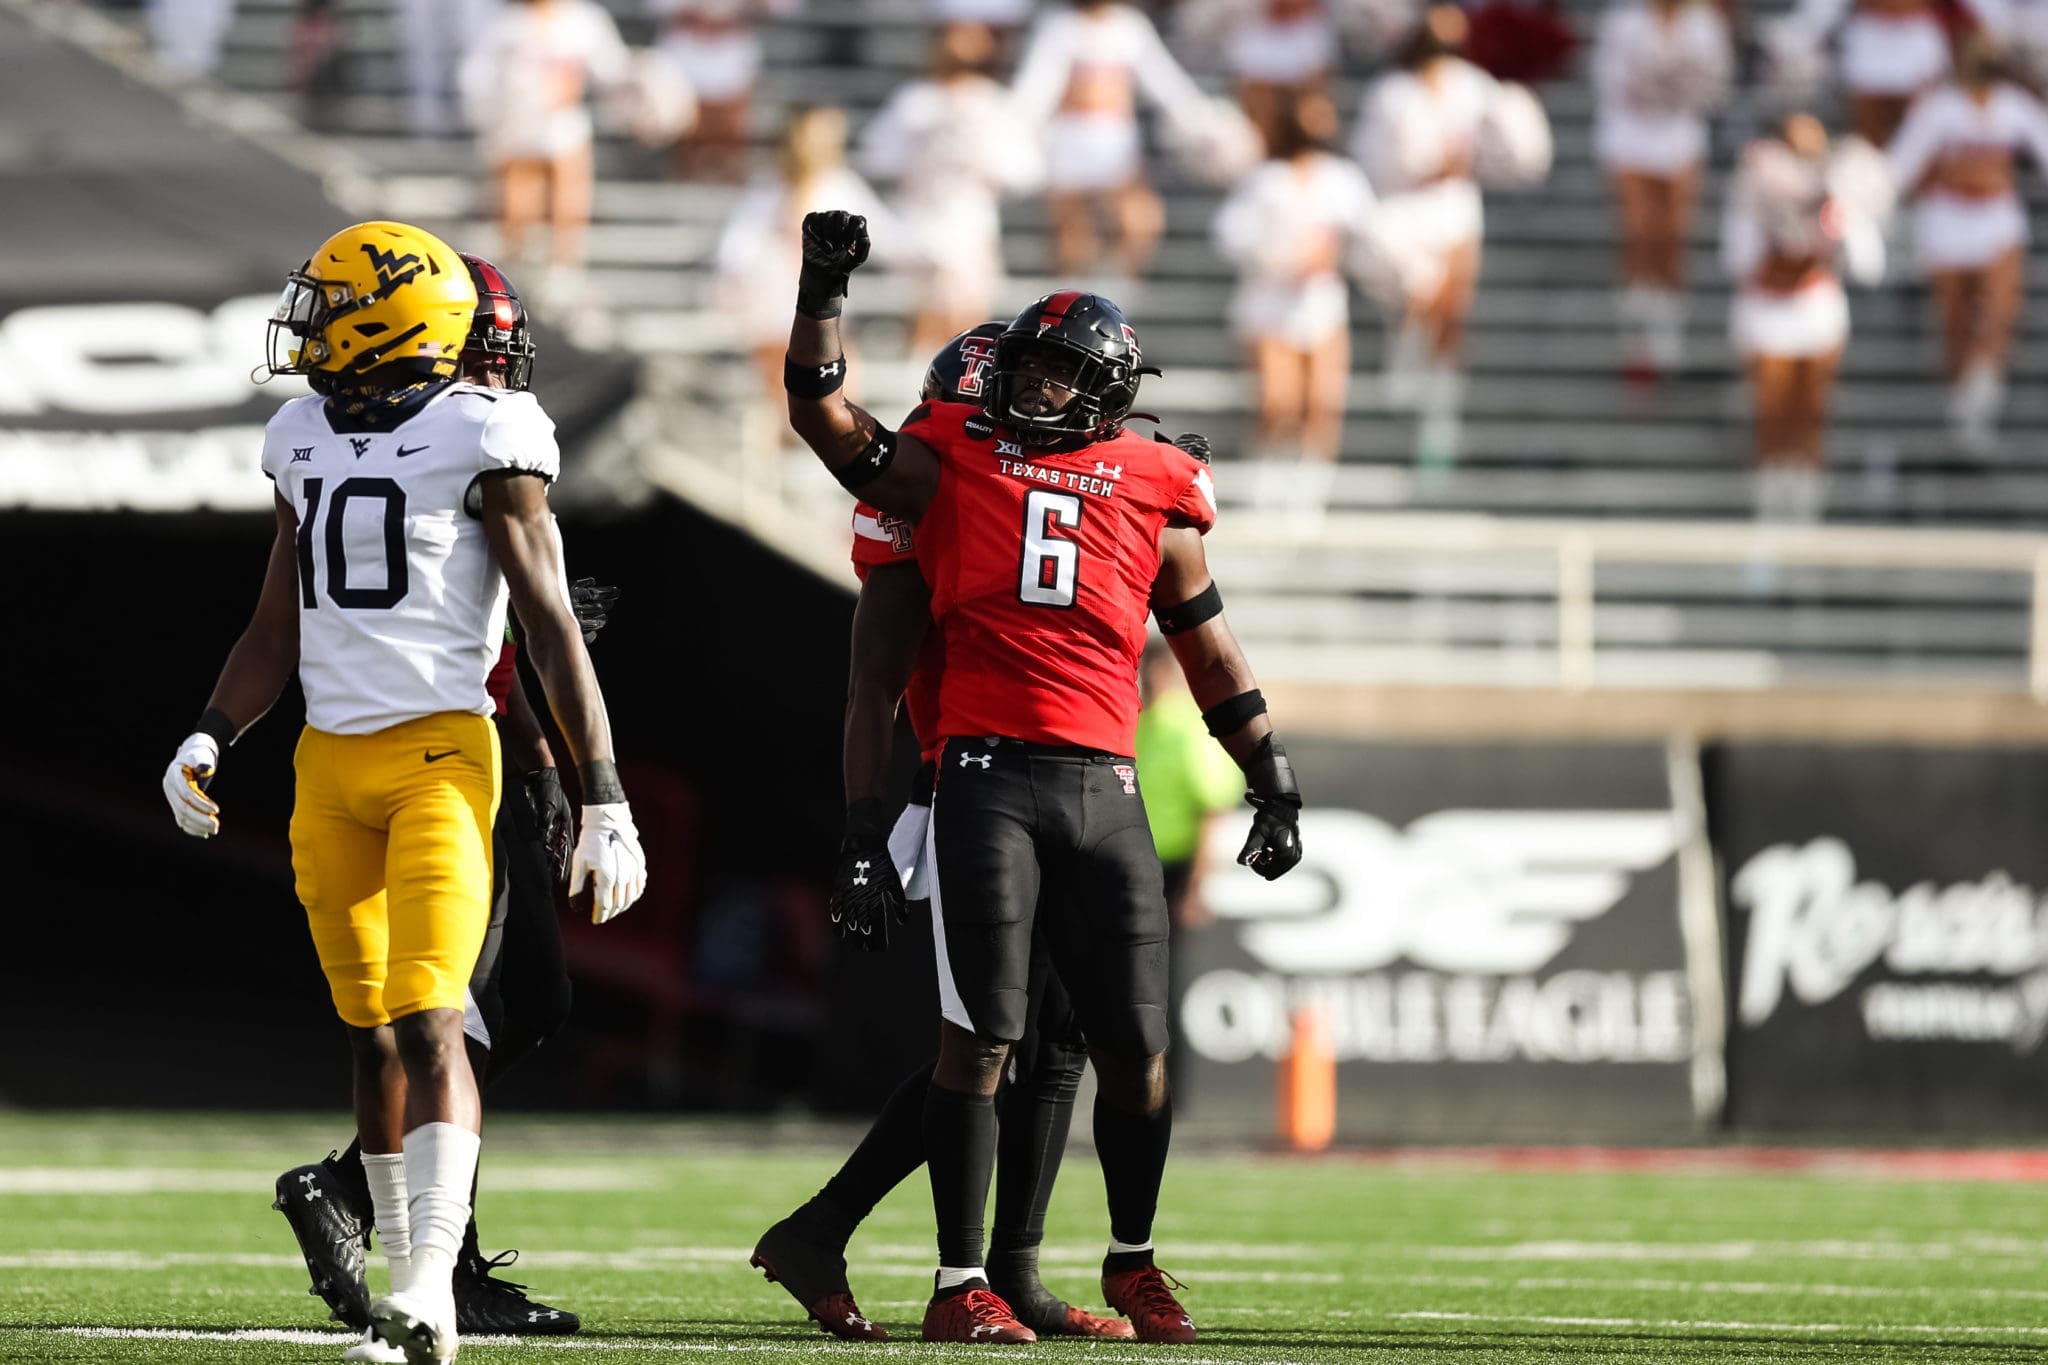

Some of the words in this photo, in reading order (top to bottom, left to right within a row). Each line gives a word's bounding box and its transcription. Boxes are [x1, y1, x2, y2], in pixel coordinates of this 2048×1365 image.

[965, 420, 994, 434] EQUALITY
[290, 446, 316, 464] XII
[994, 438, 1025, 458] XII
[999, 458, 1061, 484] TEXAS
[1065, 472, 1115, 498] TECH
[297, 476, 409, 610] 10
[1017, 487, 1084, 610] 6
